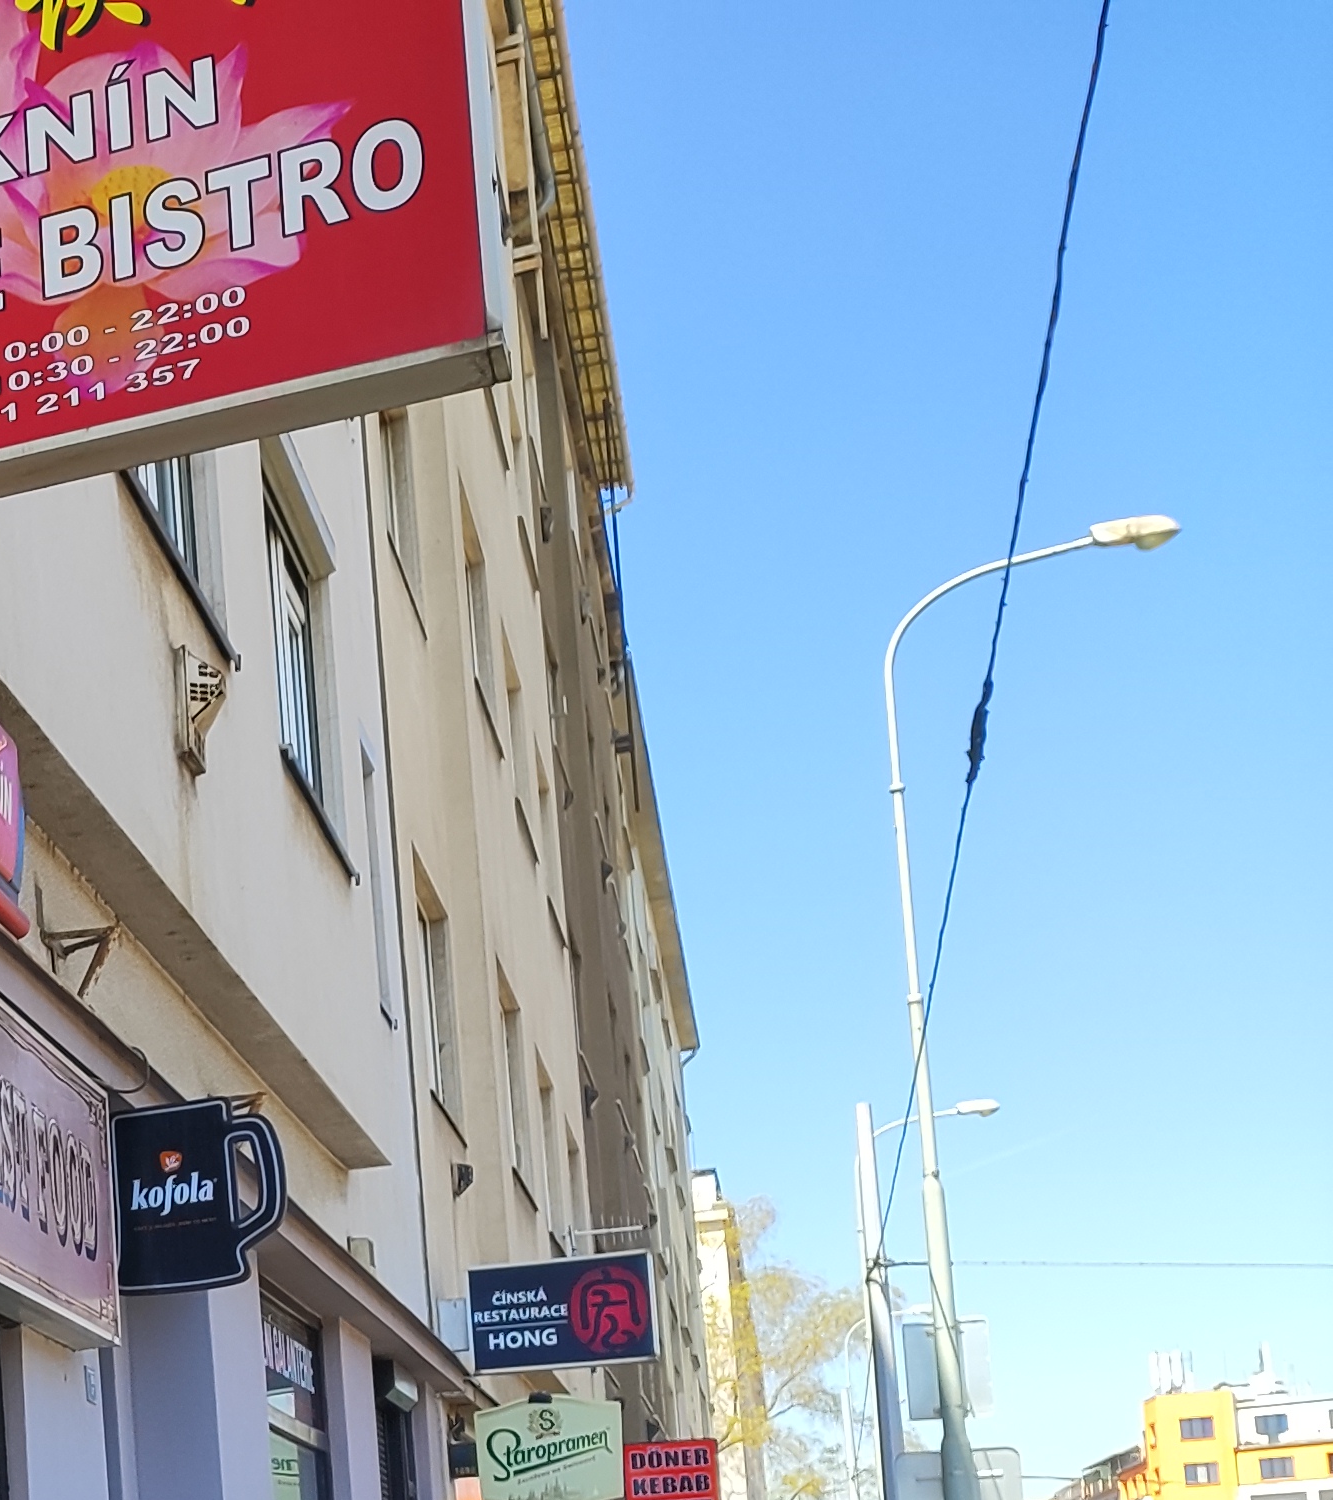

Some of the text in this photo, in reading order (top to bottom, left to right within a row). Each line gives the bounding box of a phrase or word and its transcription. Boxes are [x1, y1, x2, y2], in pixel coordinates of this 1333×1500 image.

[39, 117, 425, 301] BISTRO
[130, 286, 246, 332] 22:00
[134, 316, 250, 362] 22:00
[36, 381, 106, 416] 211
[126, 357, 202, 394] 357
[32, 1103, 97, 1262] FOOD
[131, 1171, 214, 1216] kofola
[474, 1304, 568, 1324] RESTAURACE
[492, 1286, 547, 1306] ČÍNSKÁ
[489, 1328, 558, 1350] HONG
[487, 1428, 612, 1481] Staropramen
[631, 1446, 710, 1469] DÖNER
[634, 1474, 710, 1496] KEBAB
